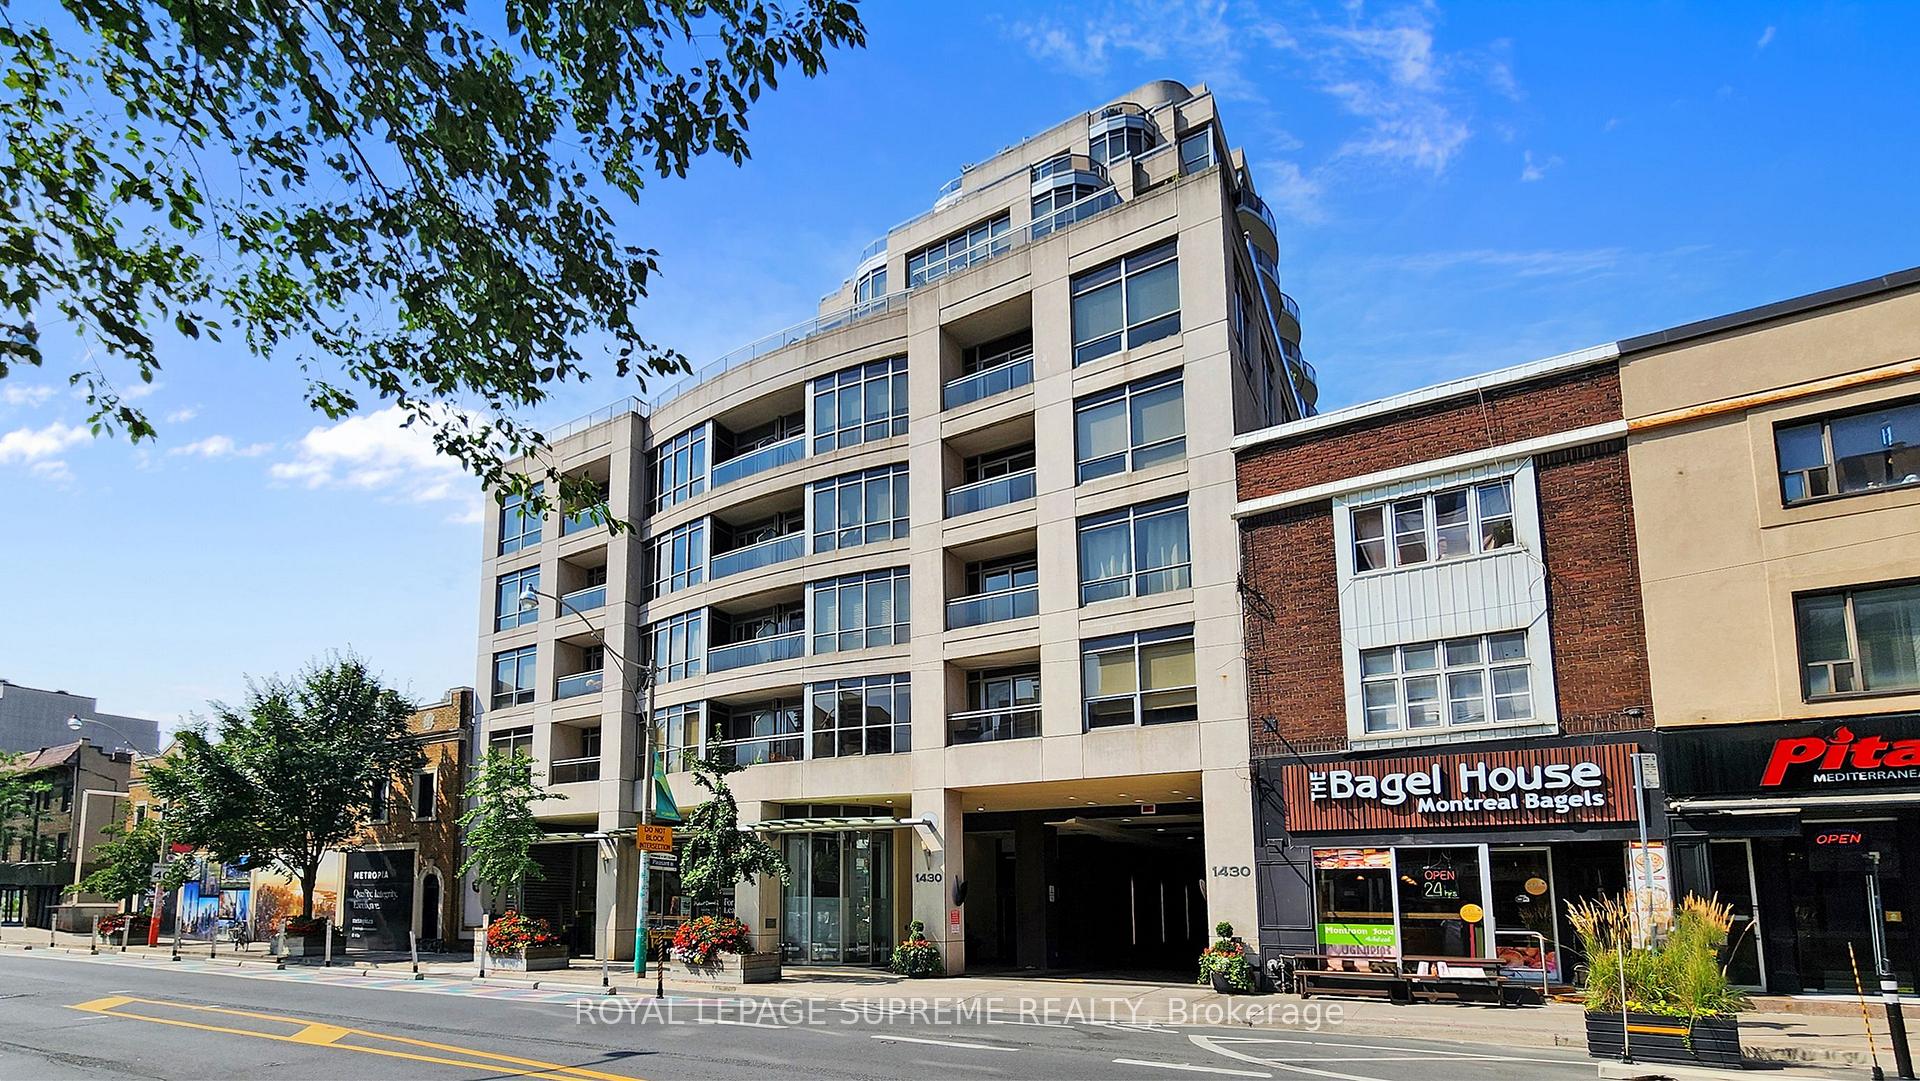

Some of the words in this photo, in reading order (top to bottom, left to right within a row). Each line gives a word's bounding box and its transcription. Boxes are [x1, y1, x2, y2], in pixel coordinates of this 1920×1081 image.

[1760, 726, 1920, 786] Pita
[1310, 771, 1327, 801] THE
[1329, 763, 1441, 806] Bagel
[1459, 761, 1602, 793] House
[1417, 792, 1518, 813] Montreal
[1525, 790, 1605, 814] Bagels
[645, 834, 665, 842] BLOCK
[1816, 833, 1862, 845] OPEN
[639, 842, 671, 850] INTERSECTION
[353, 871, 389, 880] METROPIA
[915, 873, 943, 883] 1430
[1212, 866, 1252, 878] 1430
[1424, 870, 1456, 881] OPEN
[1423, 881, 1442, 897] 24
[1444, 889, 1458, 898] hrs
